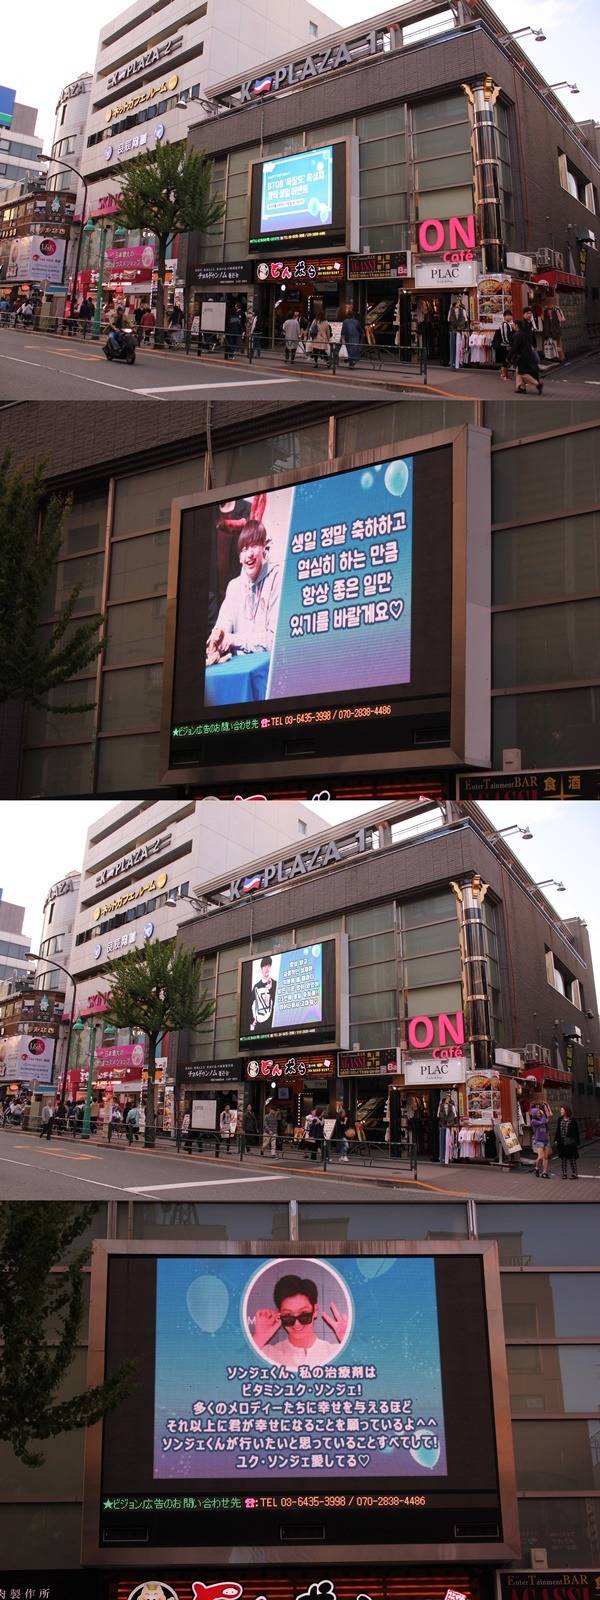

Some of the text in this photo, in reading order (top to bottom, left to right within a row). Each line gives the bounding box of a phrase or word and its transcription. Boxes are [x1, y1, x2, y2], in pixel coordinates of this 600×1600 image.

[126, 47, 160, 76] PLAZA
[241, 30, 377, 102] K PLAZA 1
[419, 215, 476, 252] ON
[443, 248, 474, 263] Café
[431, 268, 459, 279] PLAC
[291, 511, 407, 553] 생일 정말 축하하고
[297, 541, 399, 580] 열심히 하는 만큼
[302, 571, 392, 606] 항상 좋은 일만
[290, 609, 329, 637] 있기를
[544, 776, 556, 791] 食
[115, 846, 149, 875] PLAZA
[230, 828, 366, 901] K PLAZA 1
[408, 1011, 465, 1049] ON
[432, 1045, 463, 1060] Café
[420, 1064, 449, 1076] PLAC
[193, 1401, 412, 1415] 多くのメロディーたちに幸せを与えるほど
[260, 1497, 277, 1507] TEL
[281, 1496, 346, 1507] 03-6435-3998
[357, 1496, 426, 1506] 070-2838-4486
